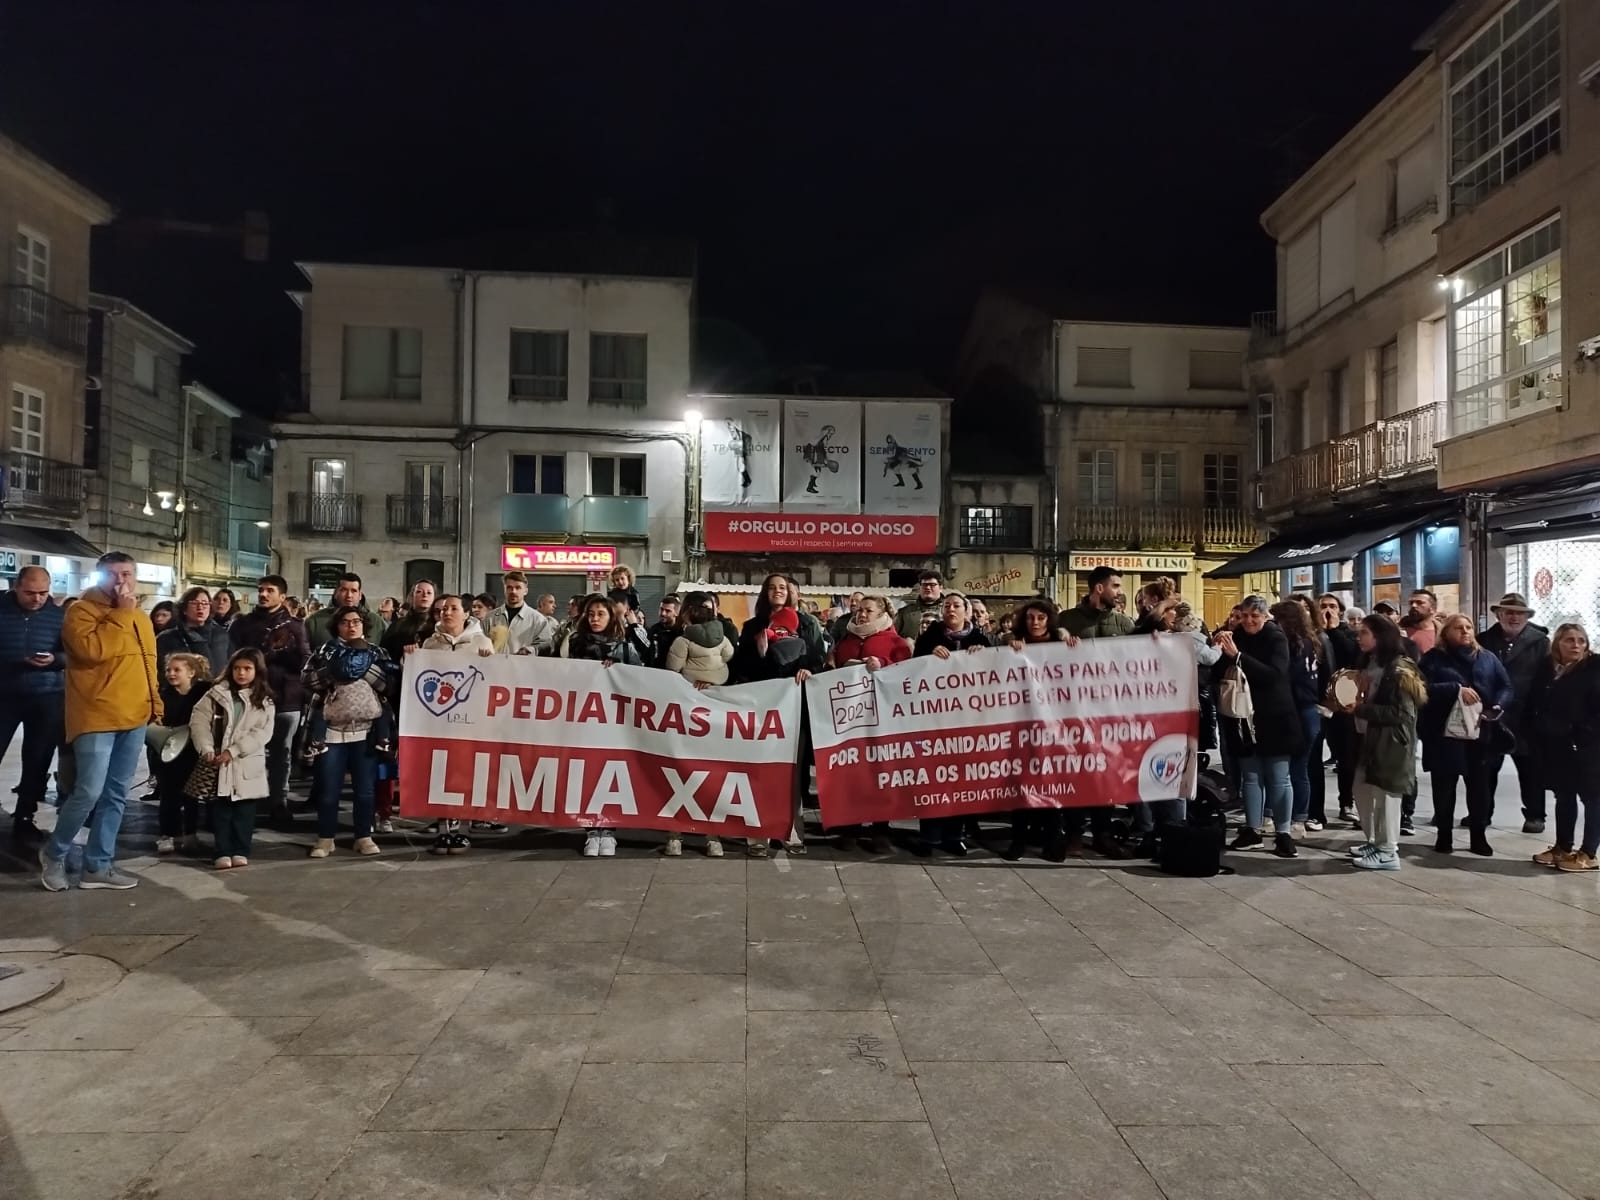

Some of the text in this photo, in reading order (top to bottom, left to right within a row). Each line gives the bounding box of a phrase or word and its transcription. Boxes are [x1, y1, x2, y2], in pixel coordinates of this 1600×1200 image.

[728, 520, 915, 536] #ORGULLO POLO NOSO
[534, 551, 612, 564] TABACOS
[1074, 556, 1187, 568] FERRETERIA CELSO
[902, 658, 1161, 695] É A CONTA ATRÁS PARA QUE
[486, 685, 785, 741] PEDIATRAS NA
[836, 700, 876, 725] 2024
[892, 703, 905, 718] A
[910, 697, 963, 716] LIMIA
[968, 689, 1030, 712] QUEDE
[1078, 679, 1177, 701] PEDIATRAS
[828, 720, 1156, 770] POR UNHA SANIDADE PÚBLICA DIGNA
[427, 749, 761, 828] LIMIA XA
[878, 752, 1107, 789] PARA OS NOSOS CATIVOS
[914, 782, 1076, 806] LOITA PEDIATRAS NA LIMIA
